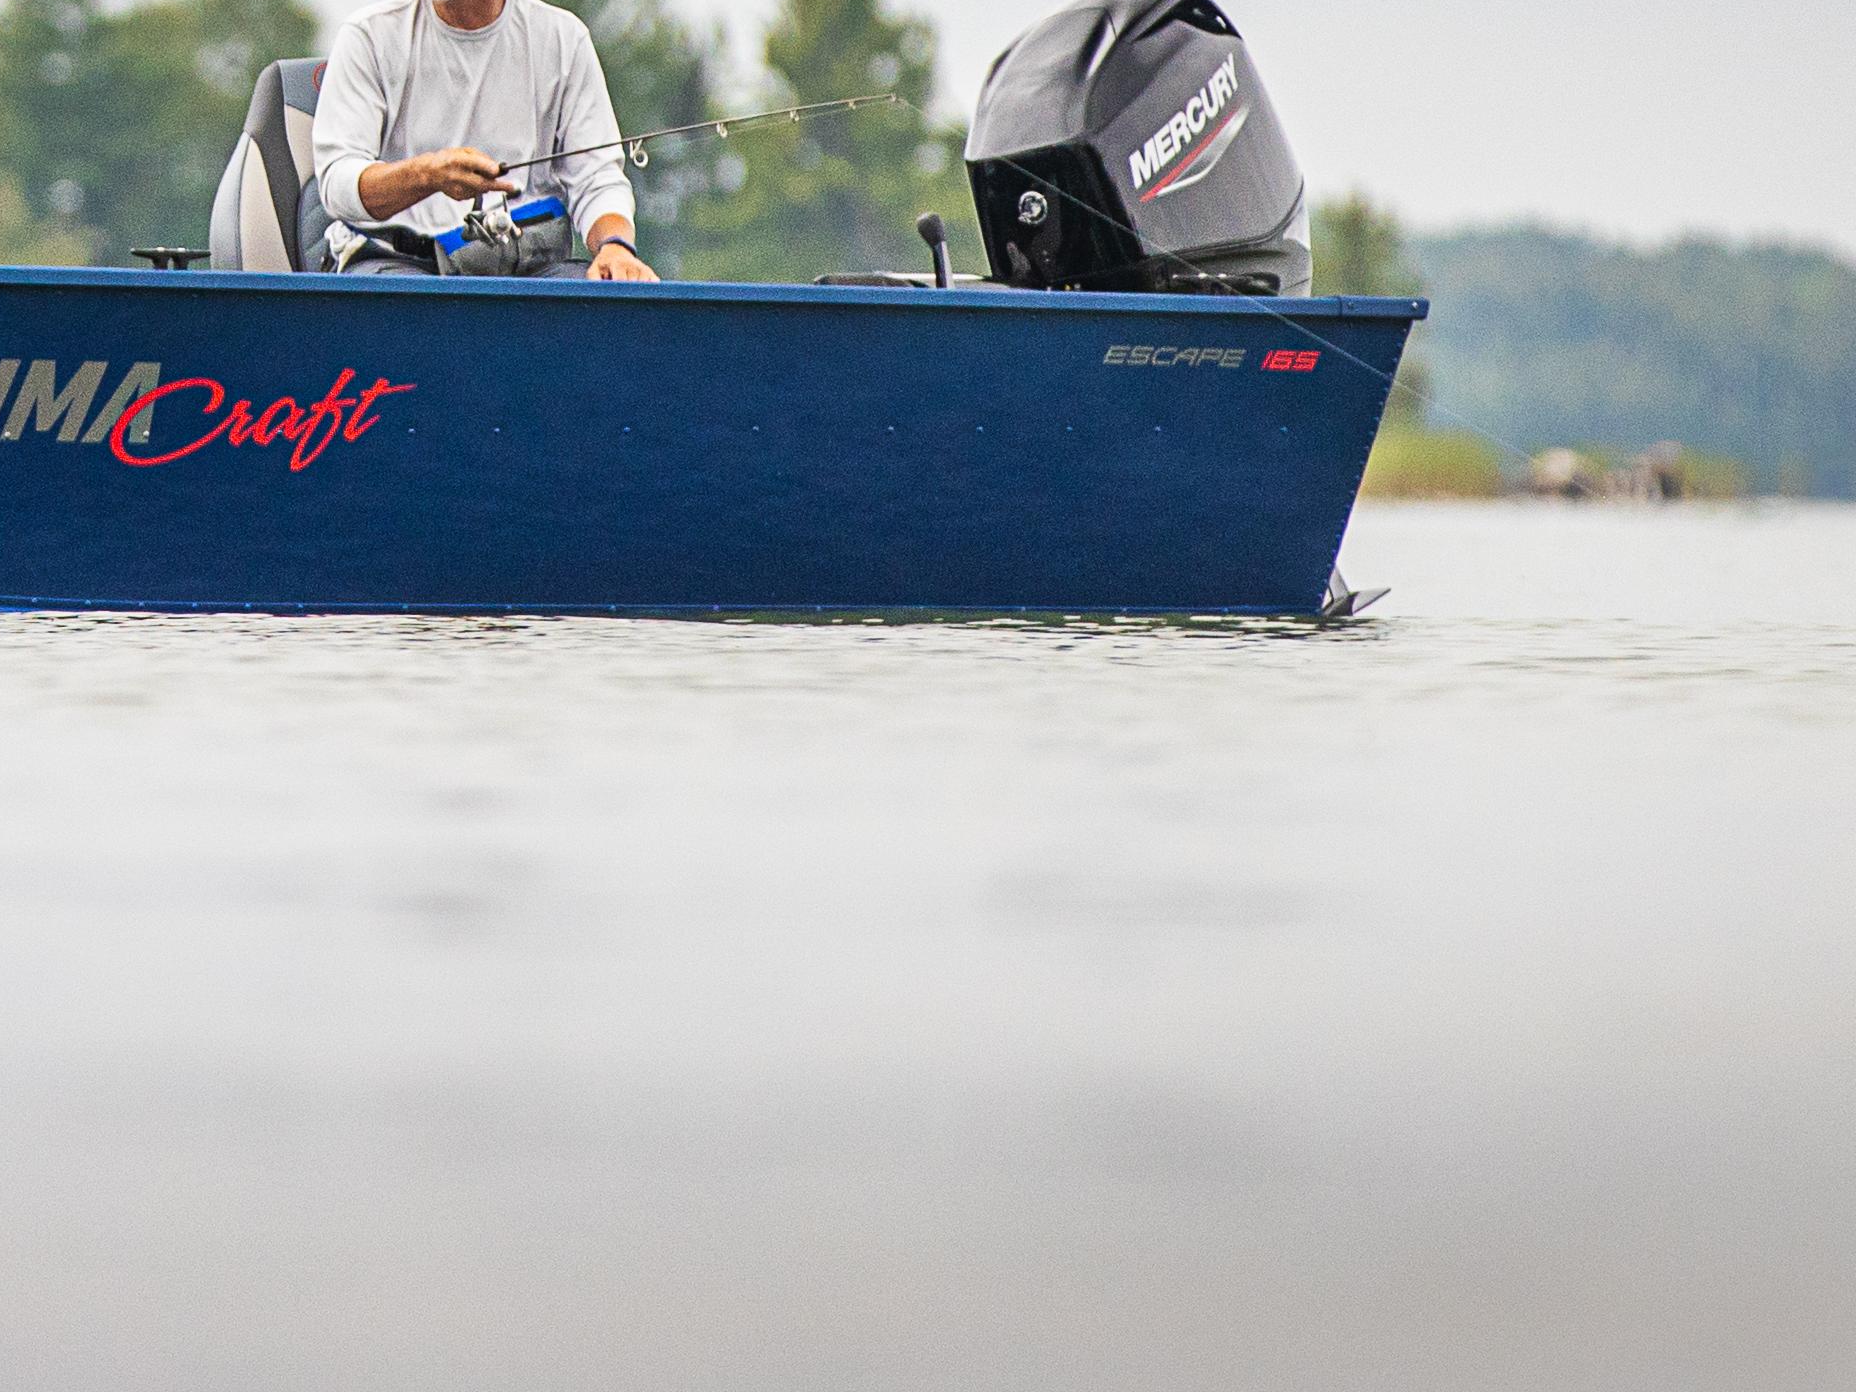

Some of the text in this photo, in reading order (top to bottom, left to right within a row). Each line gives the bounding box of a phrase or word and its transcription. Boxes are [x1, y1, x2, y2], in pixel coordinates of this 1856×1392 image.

[1129, 52, 1239, 190] MERCURY
[1103, 344, 1321, 371] ESCAPE 165
